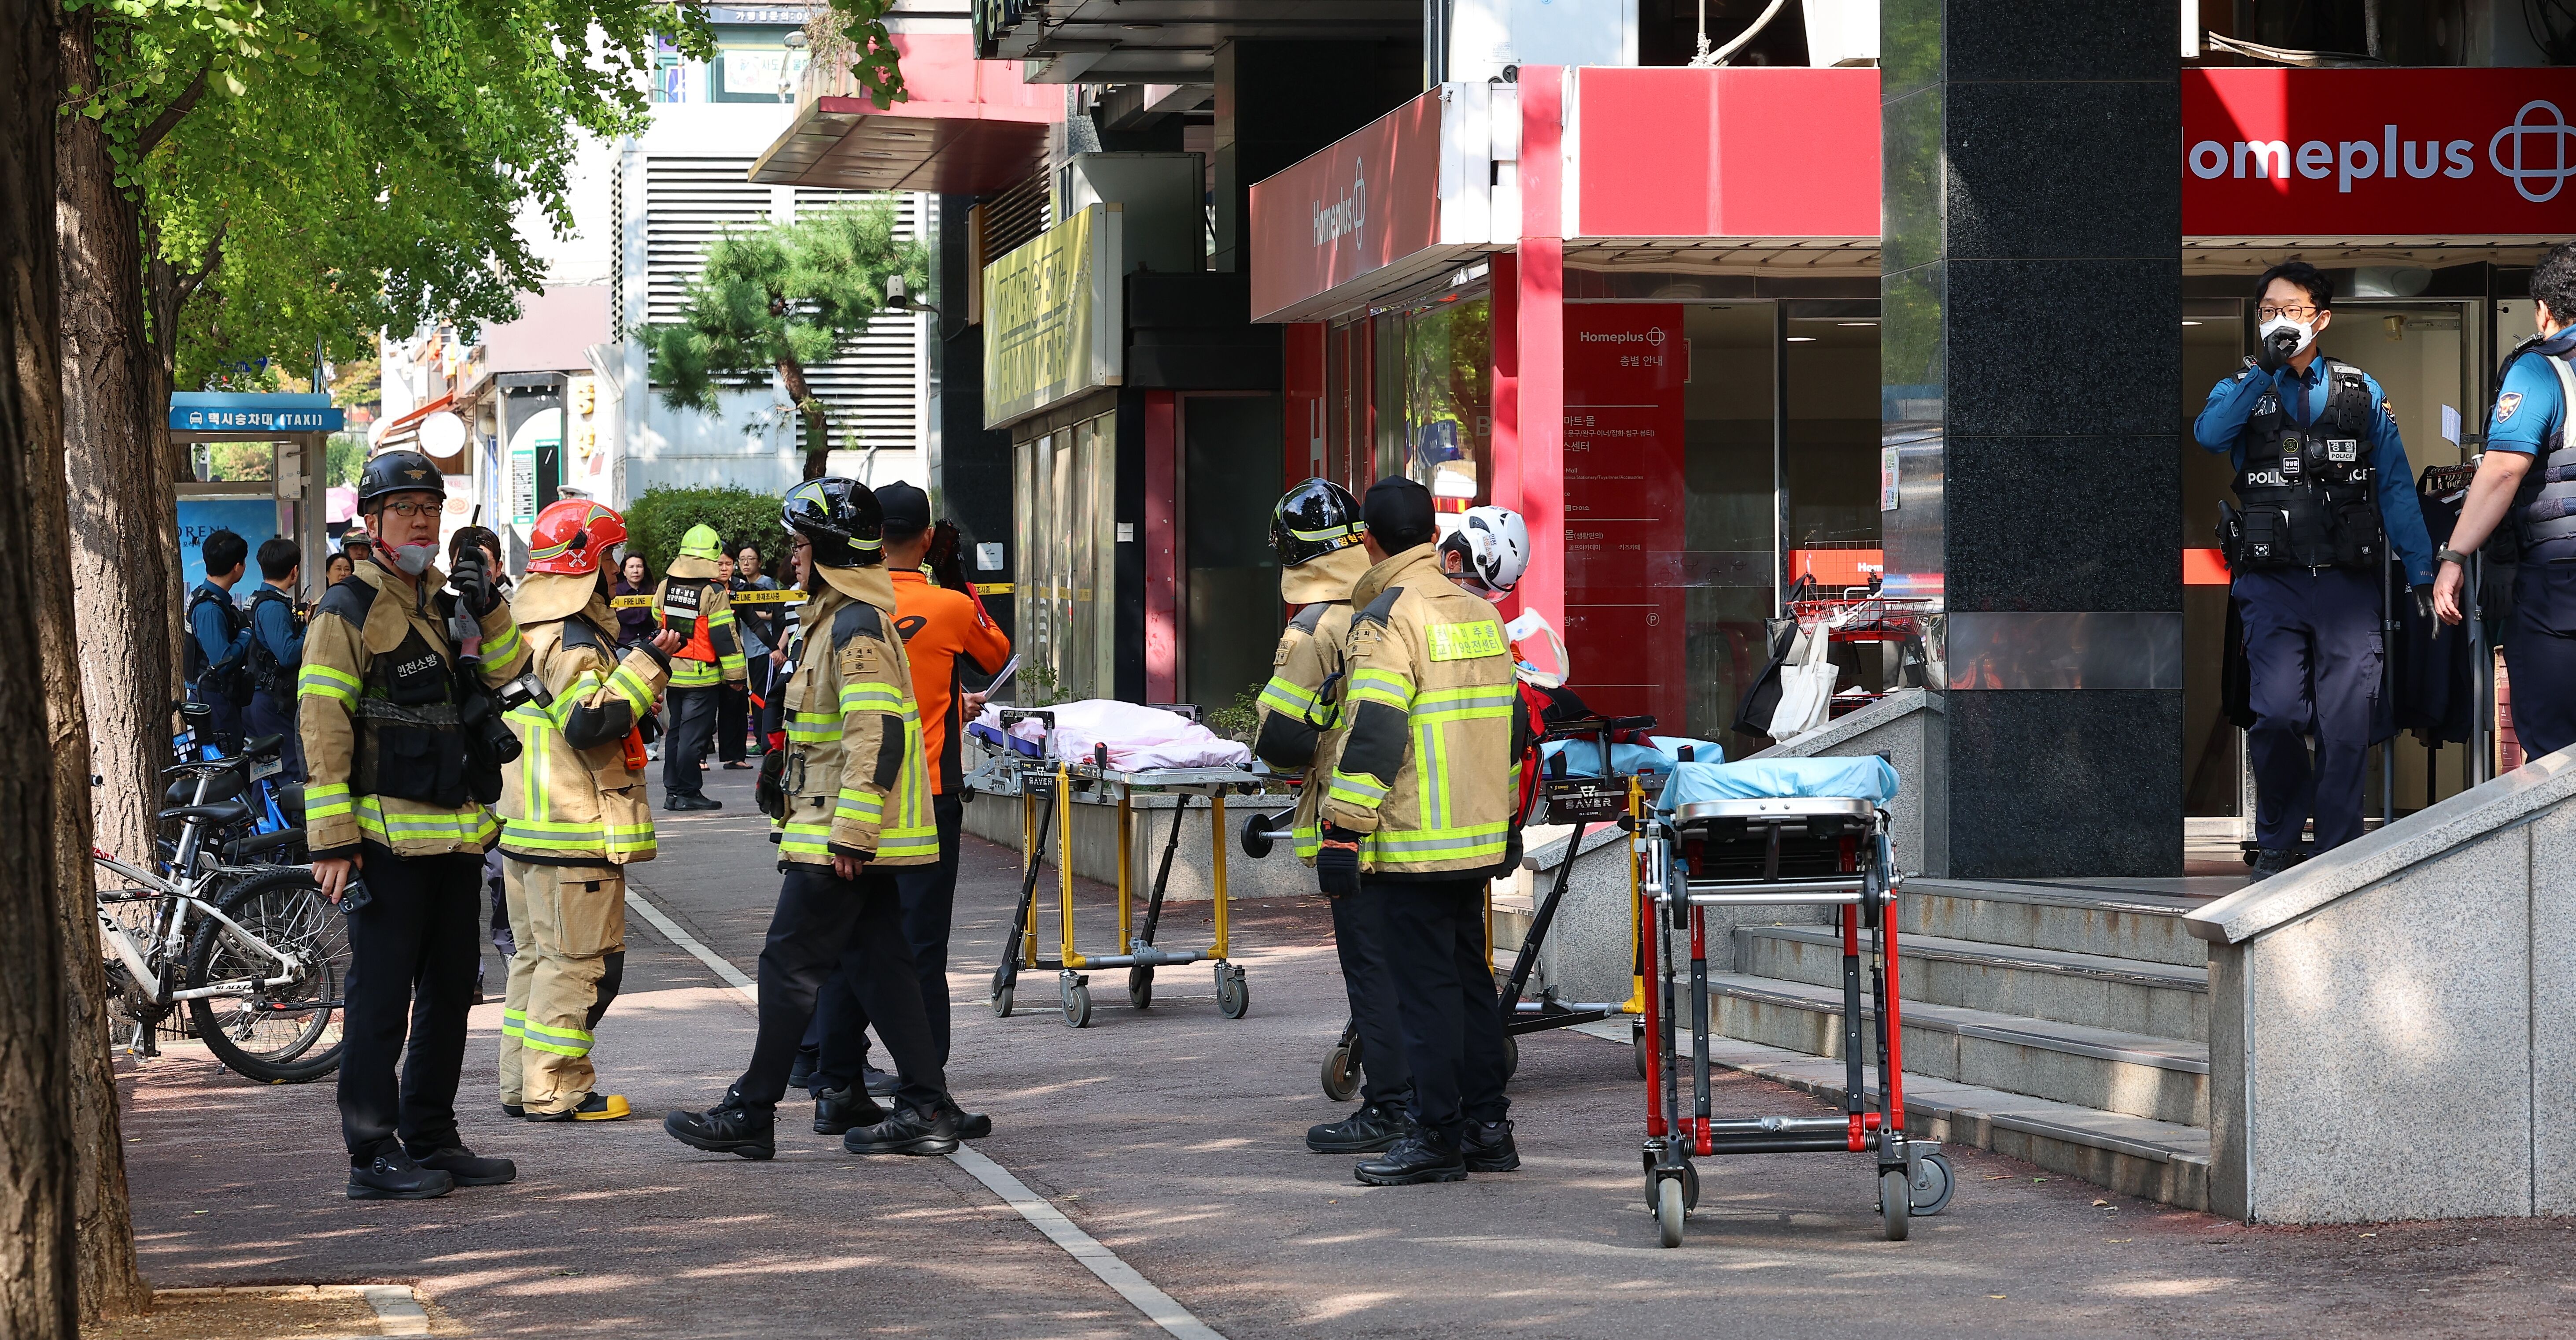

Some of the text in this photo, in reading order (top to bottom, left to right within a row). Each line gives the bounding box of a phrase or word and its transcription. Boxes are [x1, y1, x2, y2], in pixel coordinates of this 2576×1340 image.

[2181, 124, 2475, 192] omeplus
[1313, 186, 1352, 251] Homeplus
[999, 246, 1067, 342] TARGET
[1580, 331, 1644, 344] Homeplus
[1000, 321, 1066, 405] HUNTER
[1620, 355, 1663, 366] 층별 안내
[207, 411, 323, 427] 택시승차대 (TAXI)
[2331, 441, 2354, 452] 경찰
[2248, 471, 2299, 485] POLIC
[1565, 529, 1603, 540] 몰(생활편의)
[756, 592, 780, 601] 화재조사중
[397, 653, 438, 678] 인천소방
[1029, 777, 1053, 786] SAVER
[1565, 797, 1612, 810] SAVER
